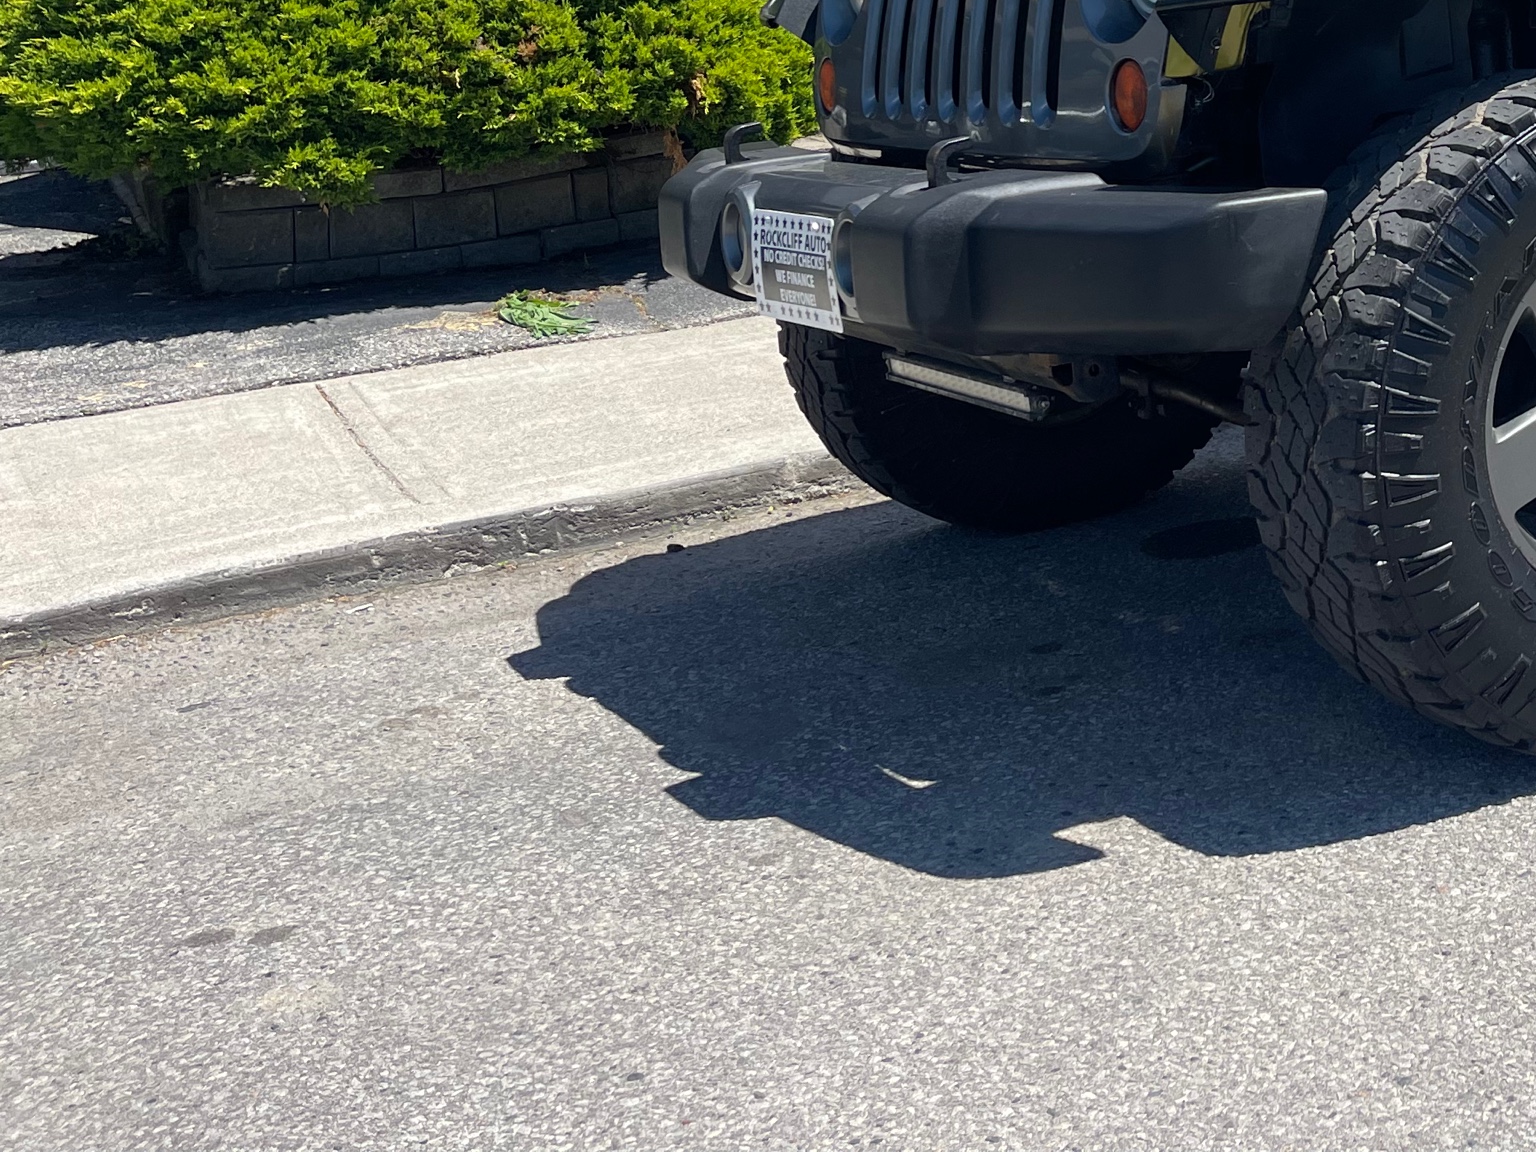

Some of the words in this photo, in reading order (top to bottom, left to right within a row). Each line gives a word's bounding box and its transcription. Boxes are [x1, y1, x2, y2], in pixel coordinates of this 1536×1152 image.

[760, 229, 803, 249] ROCKCLIFF
[804, 233, 827, 254] AUTO
[763, 250, 774, 263] NO
[775, 250, 798, 267] CREDIT
[798, 254, 825, 270] CHECKS!
[775, 268, 787, 283] WE
[787, 270, 815, 288] FINANCE
[780, 289, 817, 306] EVERYONE!
